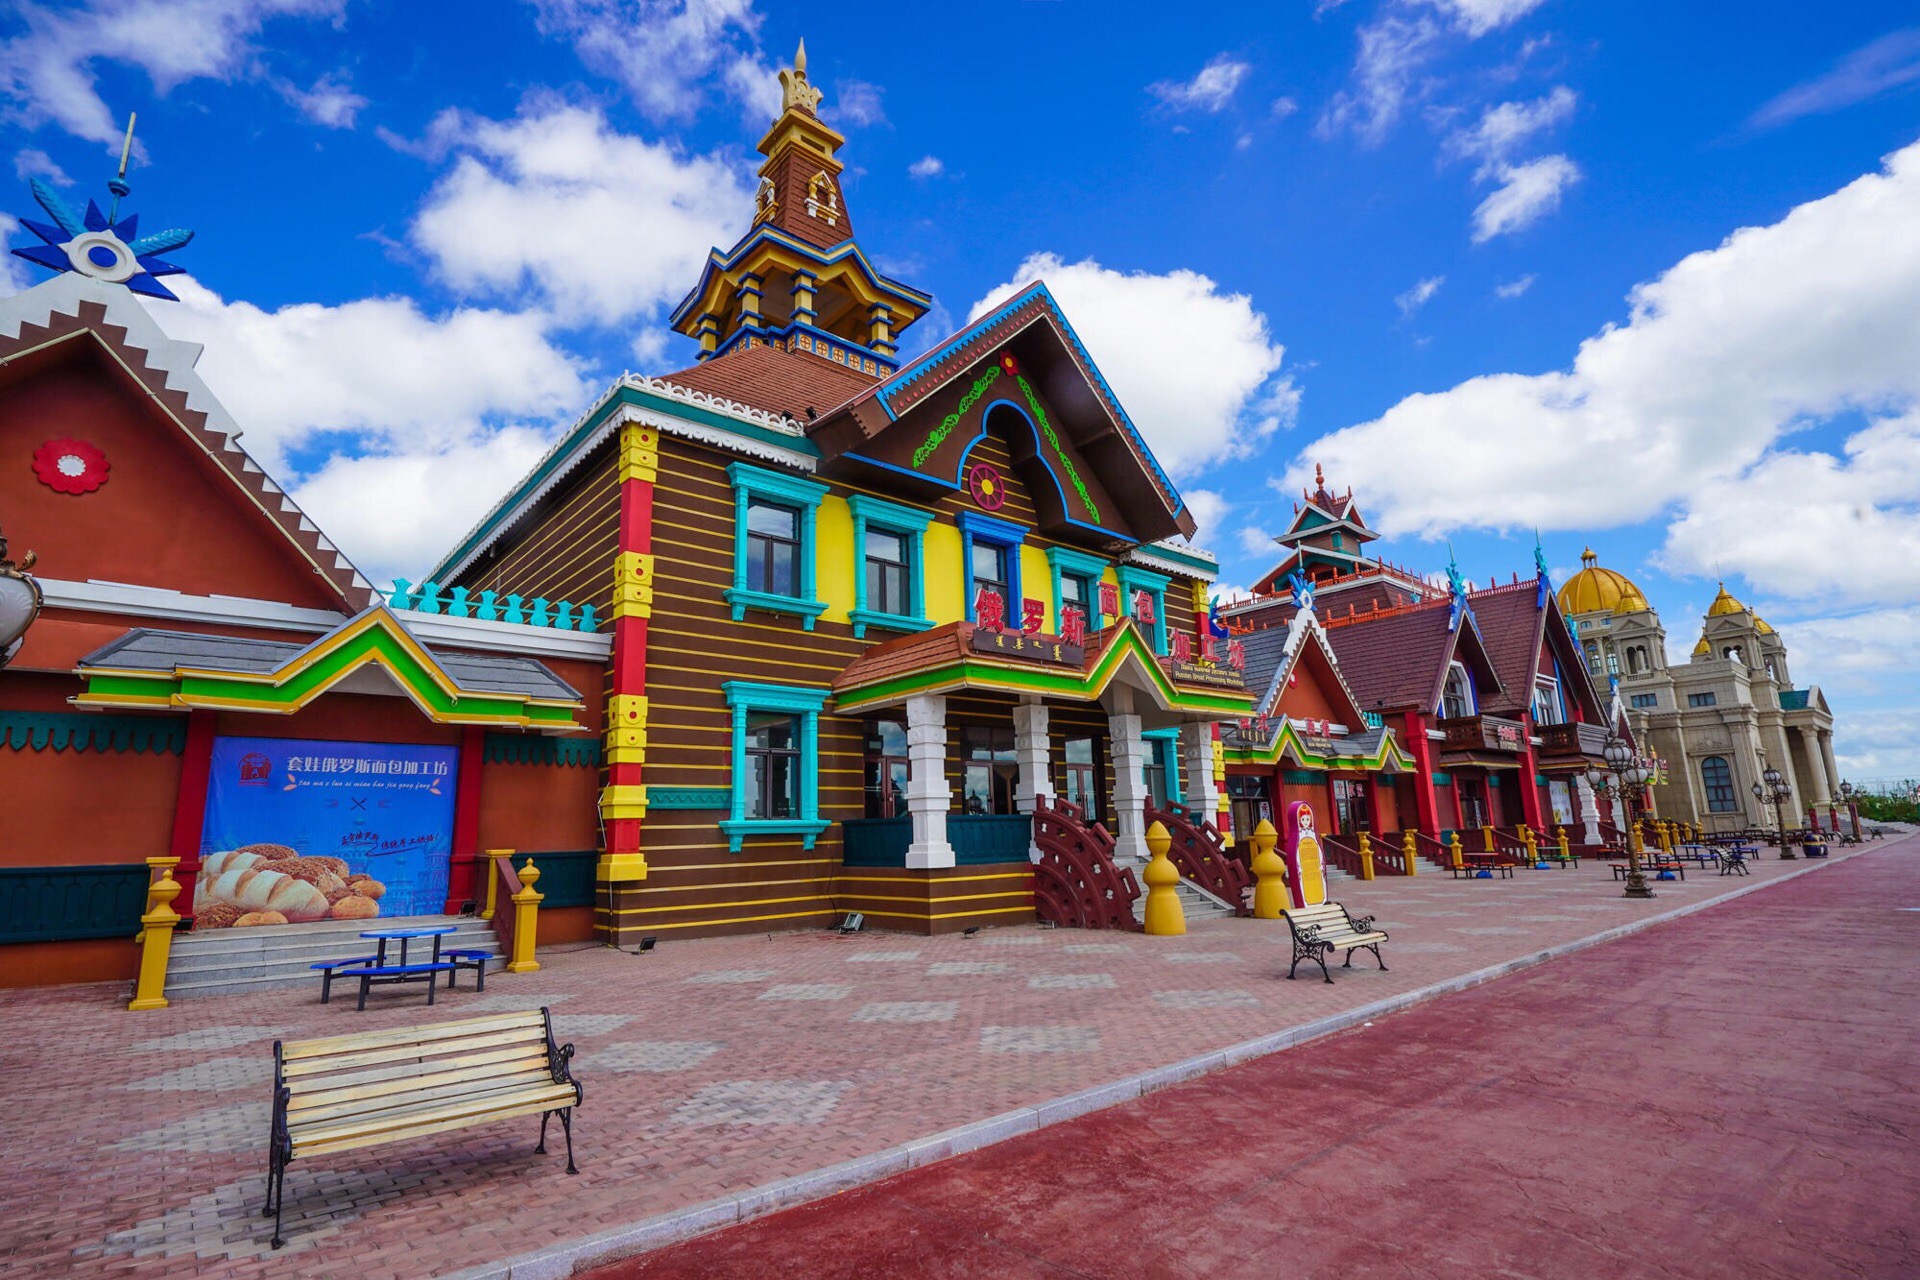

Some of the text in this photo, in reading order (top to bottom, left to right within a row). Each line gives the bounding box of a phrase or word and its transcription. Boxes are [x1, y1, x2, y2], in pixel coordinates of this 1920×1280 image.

[287, 756, 448, 776] 套娃俄罗斯面包加工坊
